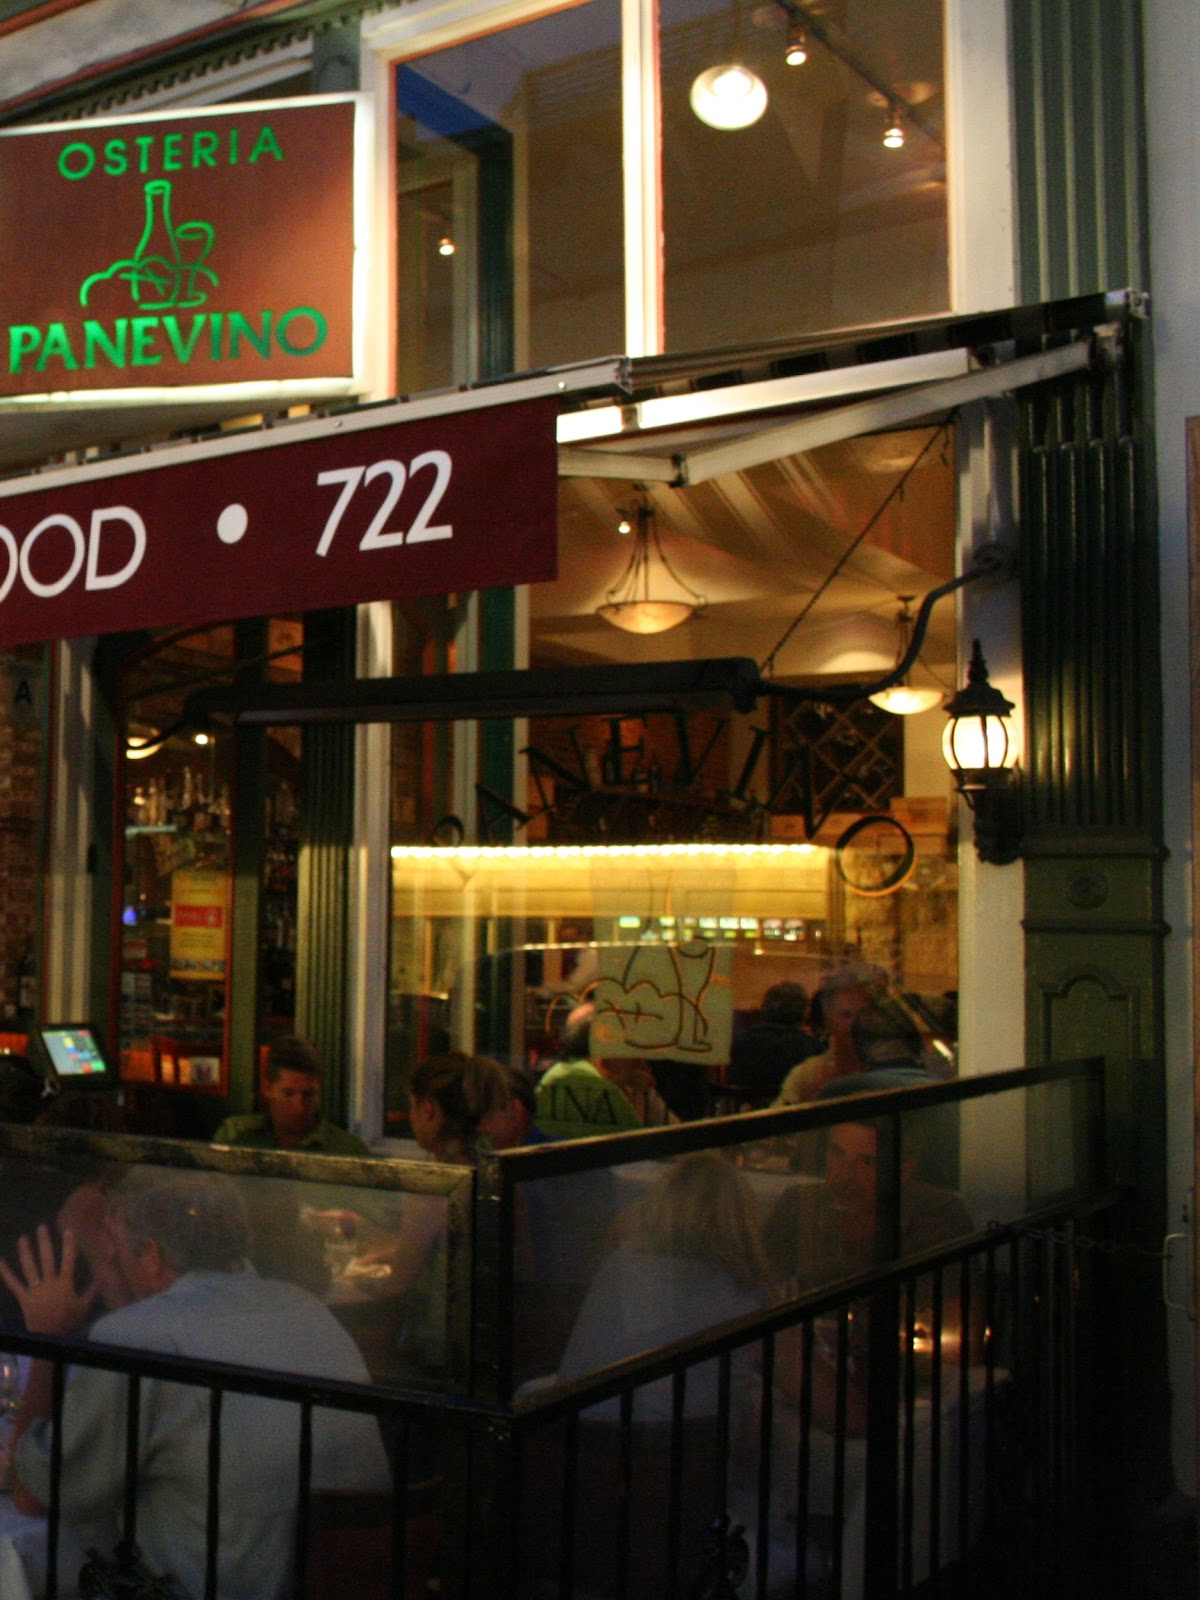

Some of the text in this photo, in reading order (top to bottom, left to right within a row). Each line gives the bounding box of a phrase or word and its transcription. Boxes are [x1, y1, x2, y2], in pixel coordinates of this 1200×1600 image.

[57, 125, 285, 181] OSTERIA
[7, 306, 329, 375] PANEVINO
[315, 449, 454, 557] 722
